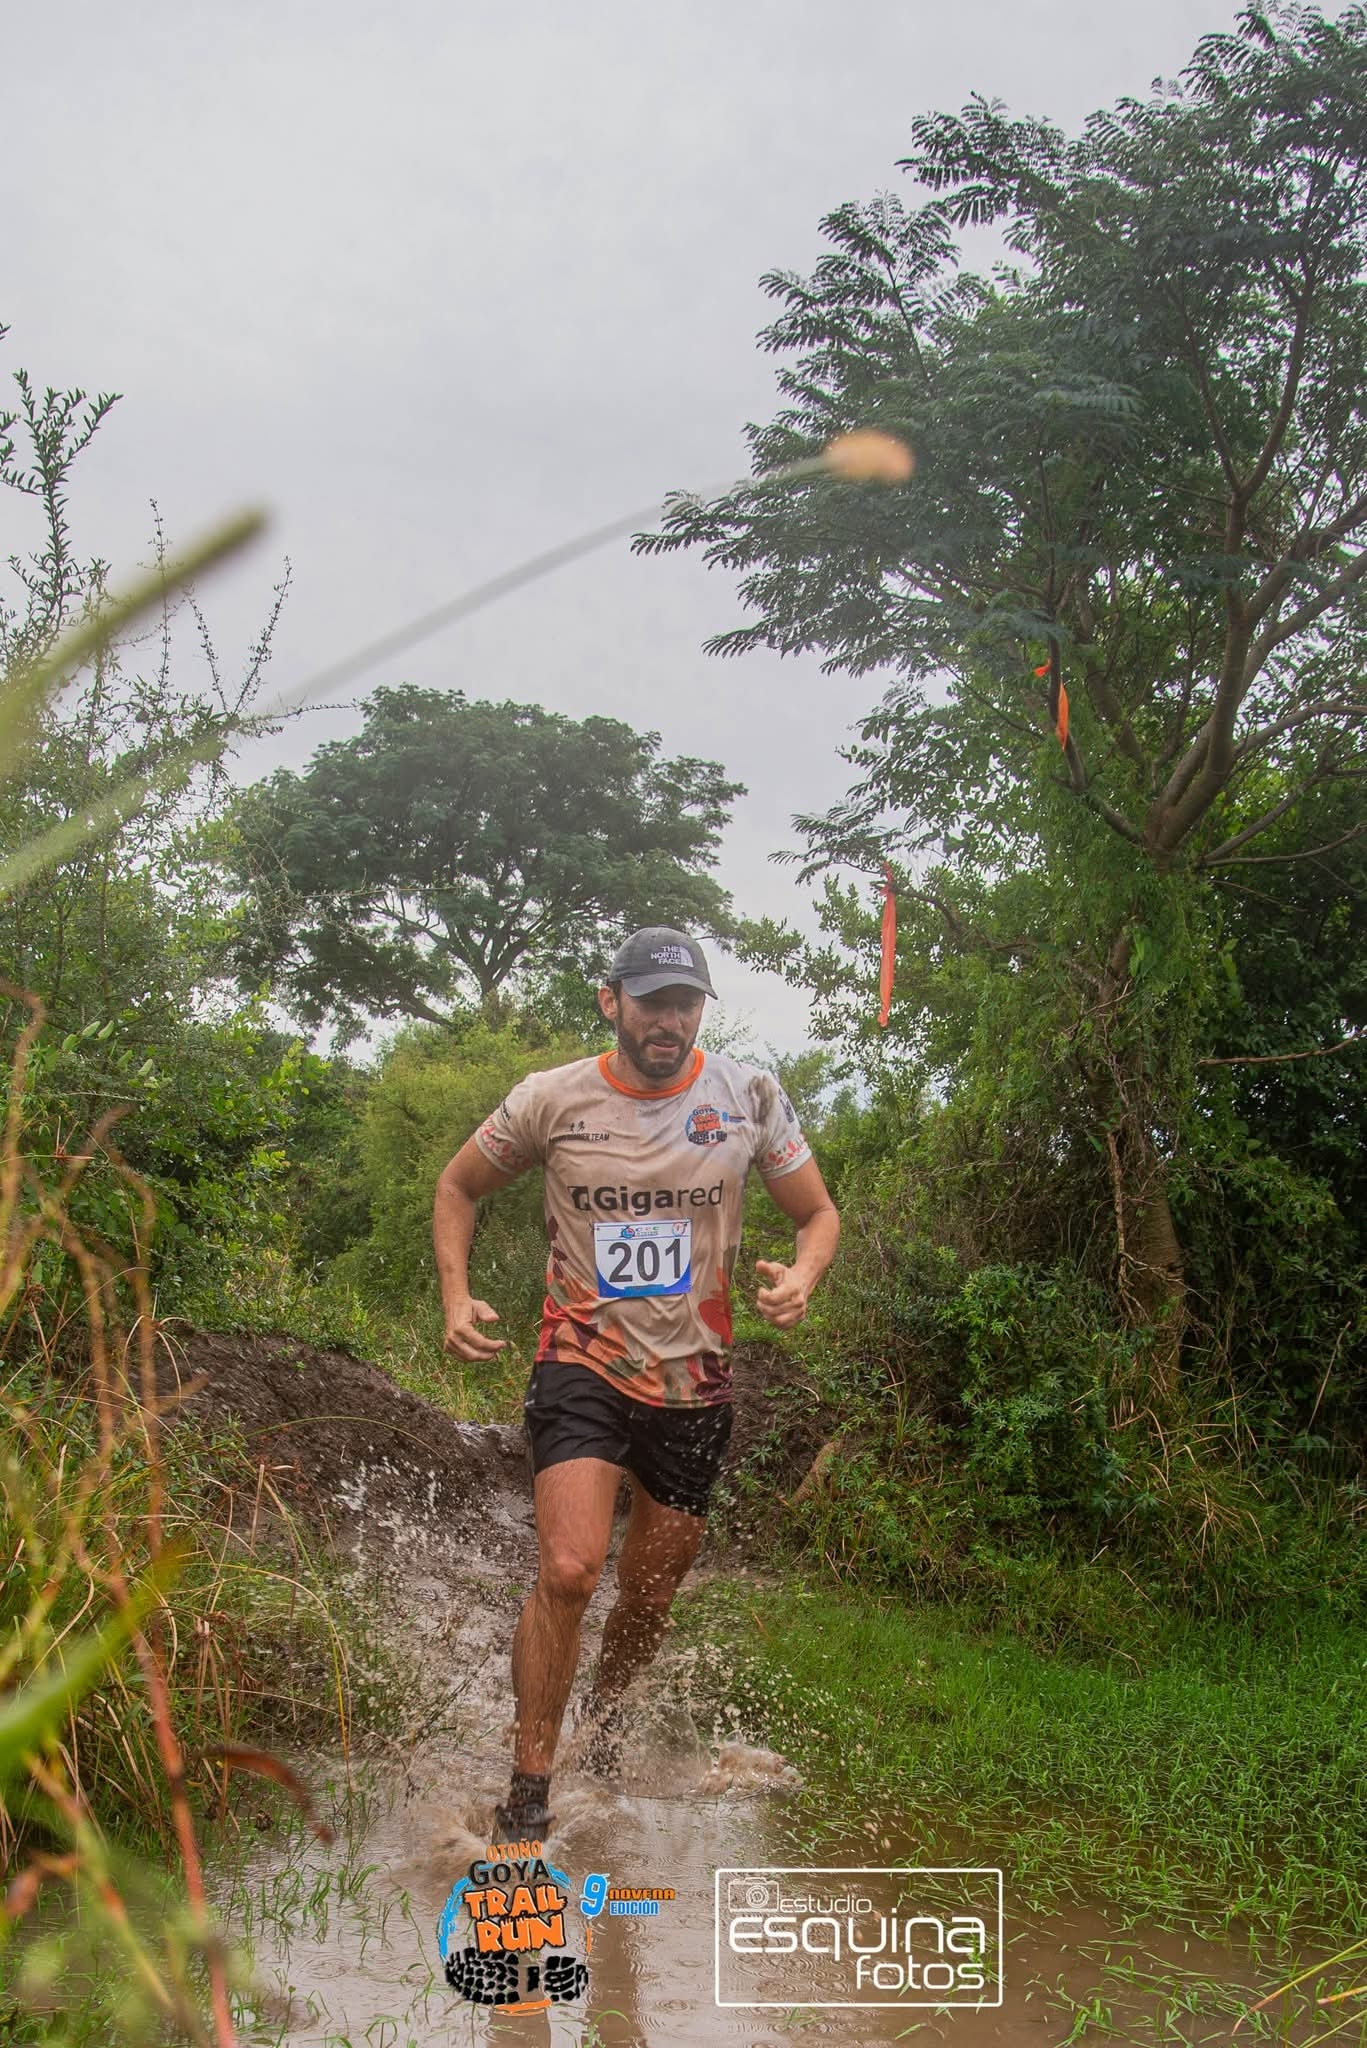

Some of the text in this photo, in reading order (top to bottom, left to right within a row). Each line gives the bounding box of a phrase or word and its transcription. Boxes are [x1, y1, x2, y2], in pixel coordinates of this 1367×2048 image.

[651, 952, 681, 960] NORTH
[594, 1180, 724, 1216] Gigared
[608, 1238, 681, 1283] 201
